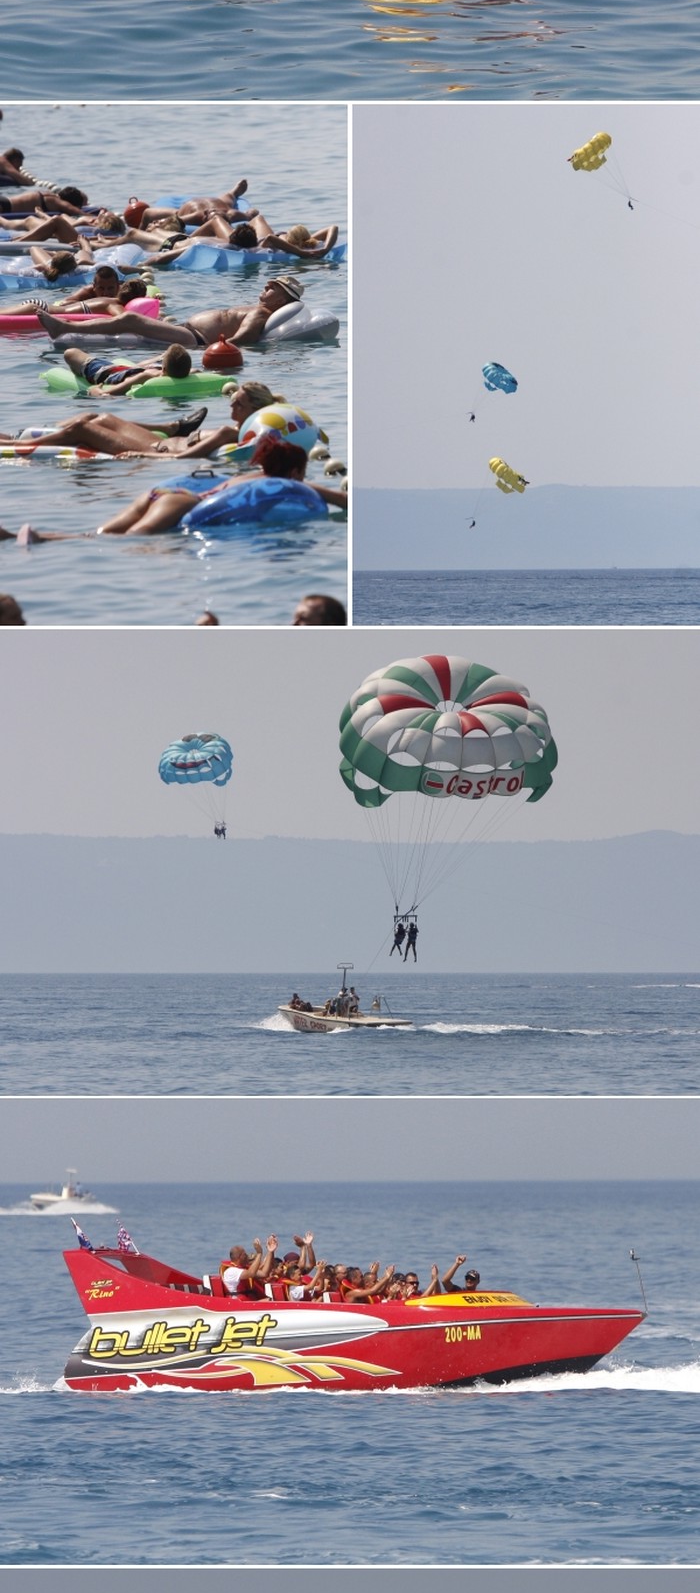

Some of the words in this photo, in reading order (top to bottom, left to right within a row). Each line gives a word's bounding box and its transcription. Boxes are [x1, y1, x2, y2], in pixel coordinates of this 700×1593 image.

[446, 771, 525, 799] Castrol
[89, 1321, 211, 1359] bullet
[210, 1313, 279, 1354] jet
[444, 1325, 481, 1343] 200-MA
